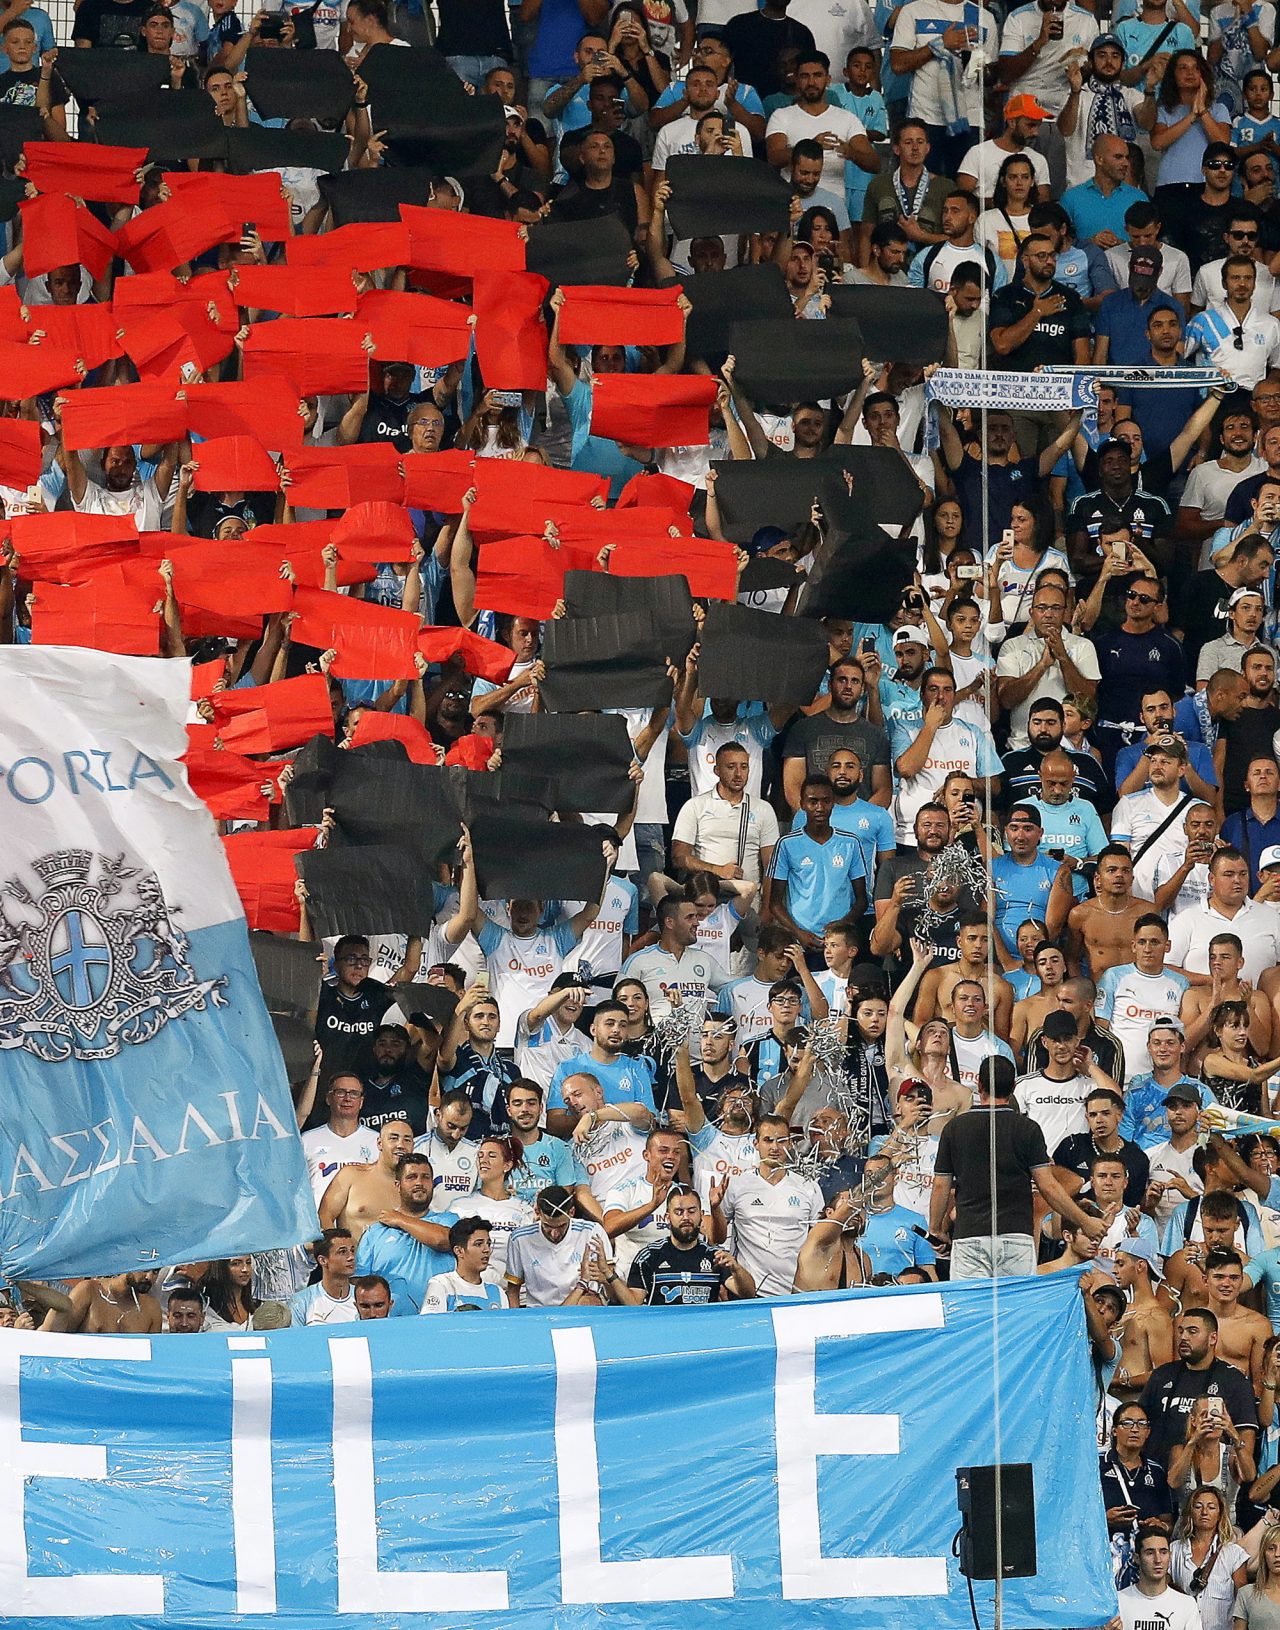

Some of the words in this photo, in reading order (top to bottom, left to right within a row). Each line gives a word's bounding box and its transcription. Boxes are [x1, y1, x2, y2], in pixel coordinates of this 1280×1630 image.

[1034, 322, 1065, 338] ange
[3, 497, 27, 513] Oran
[890, 706, 923, 722] Oran
[924, 756, 970, 771] Orange
[1041, 832, 1082, 847] range
[589, 919, 621, 934] ange
[697, 928, 723, 941] ange
[931, 944, 963, 961] ange
[680, 981, 706, 991] INTER
[681, 989, 706, 998] SPORT
[1127, 1005, 1167, 1019] Oran
[326, 1014, 373, 1036] Orange
[740, 1013, 773, 1028] Oran
[943, 1064, 981, 1084] Oang
[1035, 1095, 1074, 1105] adidas
[586, 1146, 633, 1177] Orange
[715, 1159, 743, 1177] Ora
[444, 1175, 471, 1184] INTER
[444, 1183, 470, 1193] SPORT
[1097, 1246, 1115, 1259] ran
[682, 1284, 712, 1295] INTER
[682, 1294, 711, 1304] SPORT
[1179, 1397, 1196, 1406] INT
[1178, 1405, 1193, 1414] SPO
[1134, 1619, 1167, 1630] PUMA
